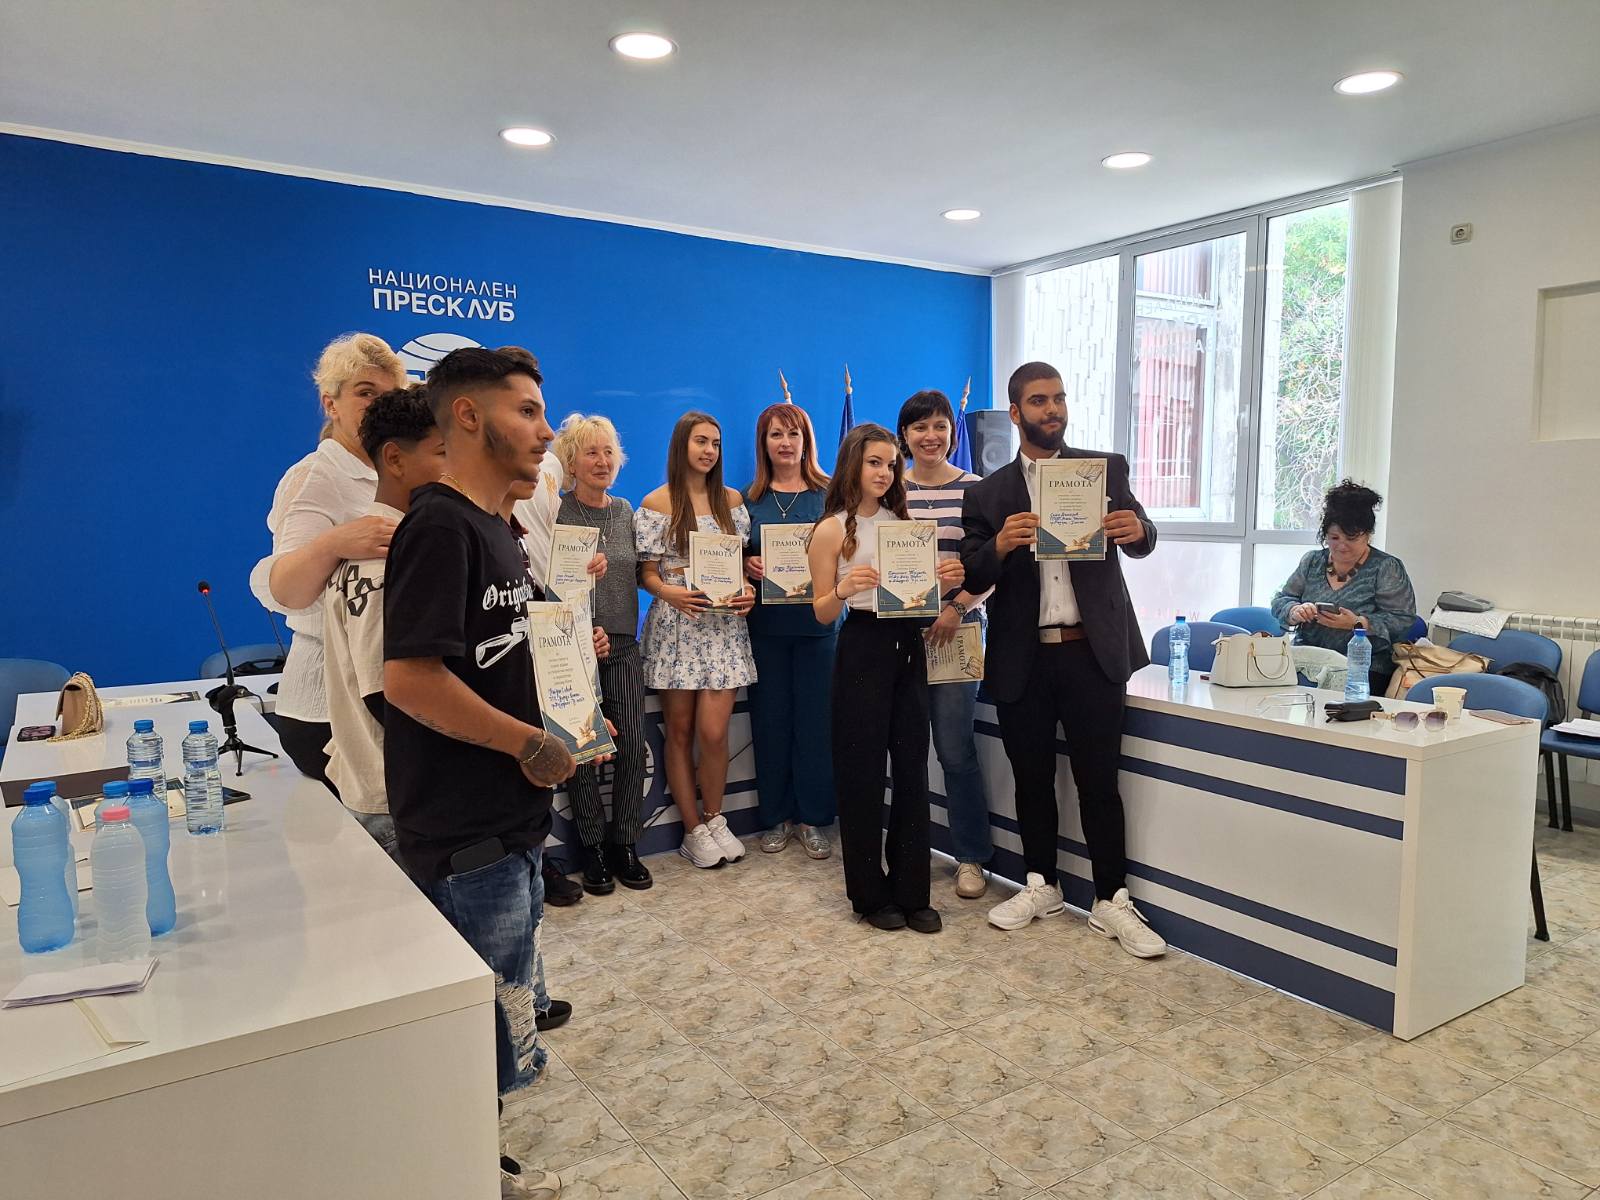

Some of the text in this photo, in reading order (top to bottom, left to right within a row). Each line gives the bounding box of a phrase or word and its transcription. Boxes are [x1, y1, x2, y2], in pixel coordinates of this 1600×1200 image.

[368, 268, 517, 299] НАЦИОНАЛЕН
[373, 288, 515, 322] ПРЕСКЛУБ
[1048, 480, 1094, 488] ГРАМОТА
[558, 543, 589, 553] ГРАМОТА
[886, 540, 928, 549] ГРАМОТА
[700, 549, 733, 558] ГРАМОТА
[538, 633, 572, 649] ГРАМОТА
[957, 635, 966, 671] ГРАМОТА
